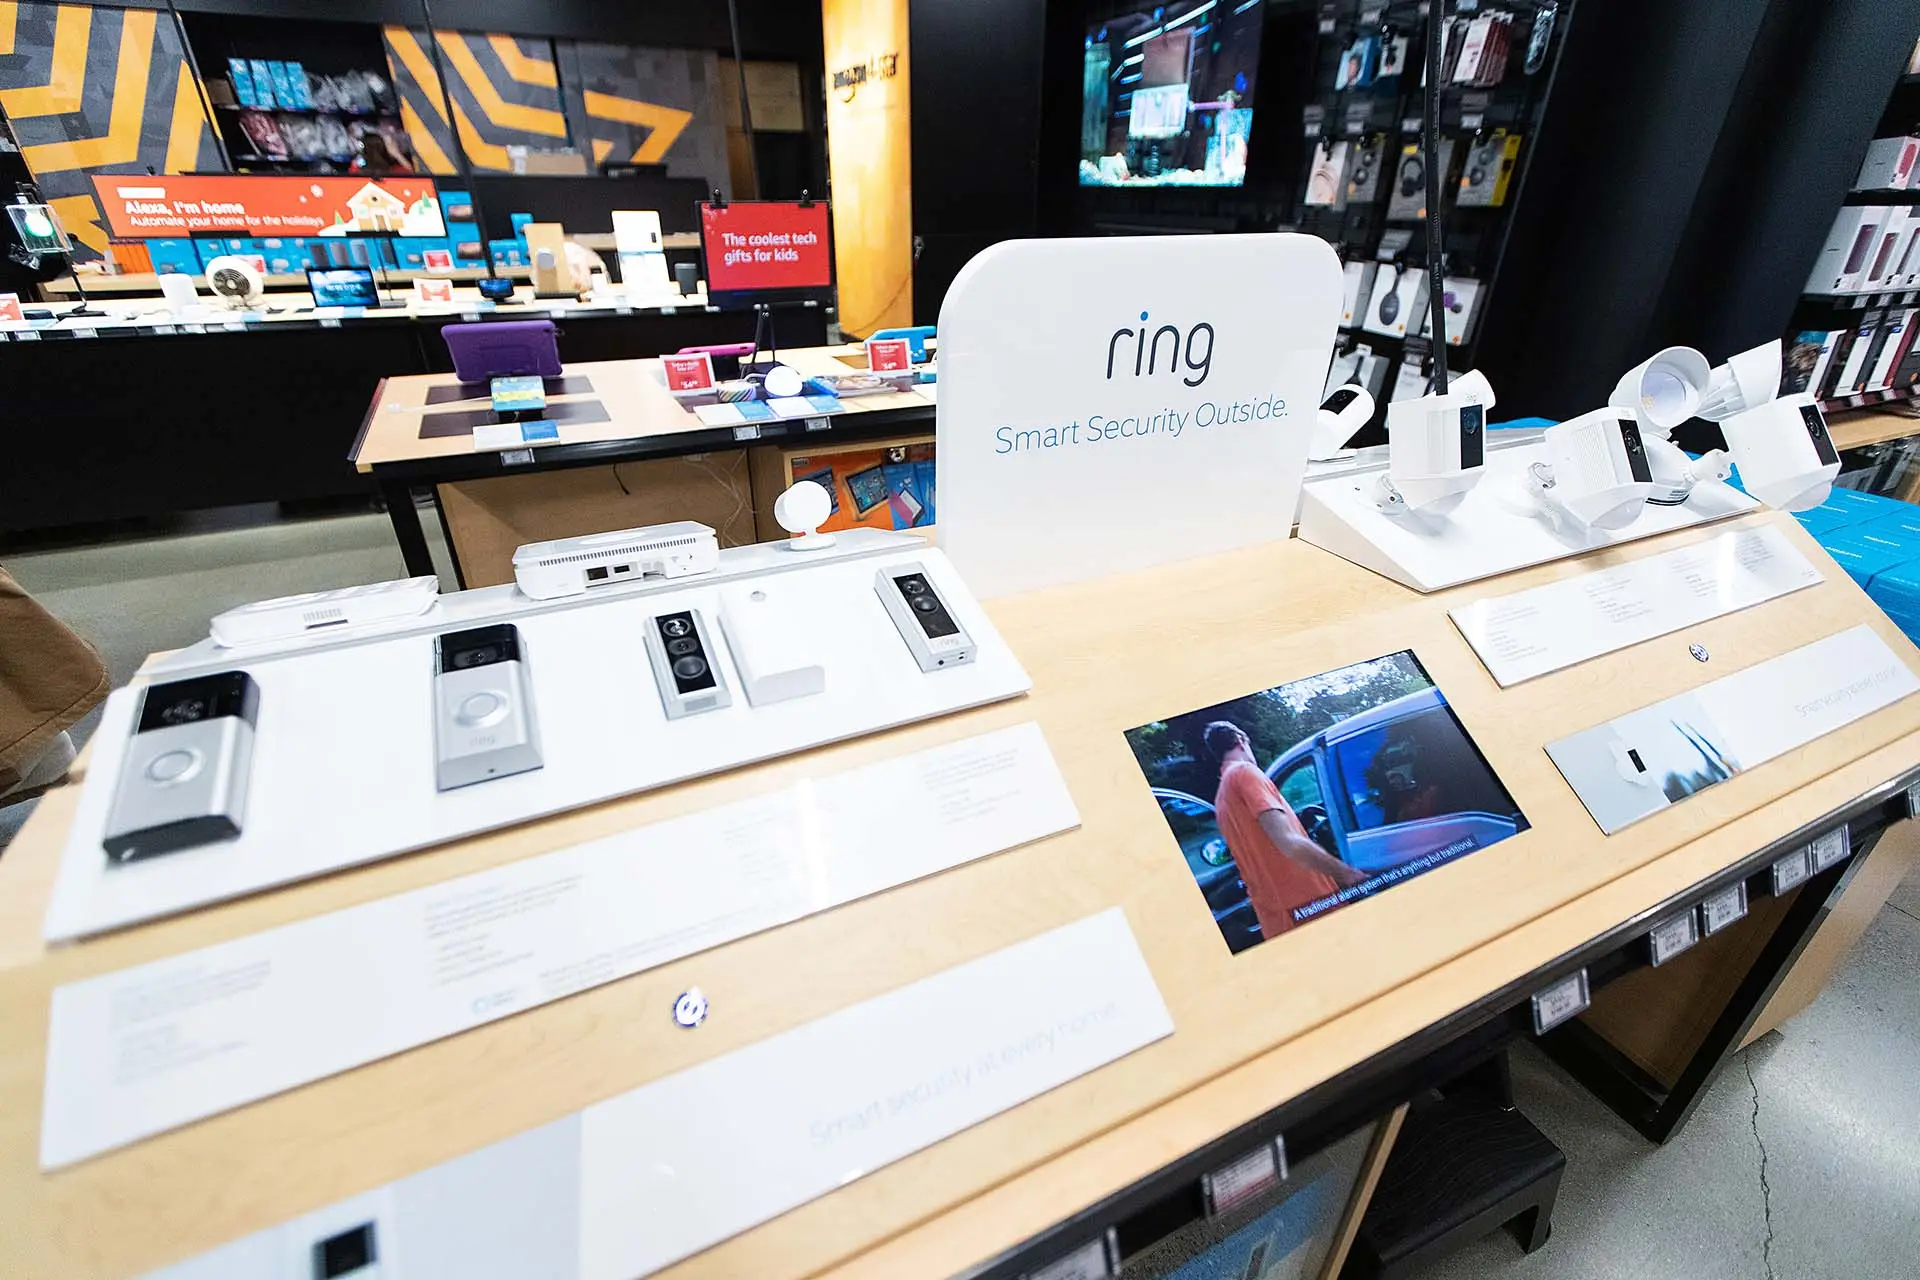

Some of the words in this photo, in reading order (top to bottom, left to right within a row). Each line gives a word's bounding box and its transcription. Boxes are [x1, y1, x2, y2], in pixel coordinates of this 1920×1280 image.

[125, 200, 173, 217] Alexa,
[175, 200, 200, 214] I'm
[201, 200, 245, 215] home
[130, 215, 185, 227] Automate
[187, 217, 211, 228] your
[213, 215, 247, 227] home
[247, 215, 261, 226] for
[263, 214, 281, 226] the
[722, 233, 746, 246] The
[748, 232, 791, 245] coolest
[792, 231, 817, 245] tech
[724, 250, 753, 266] gifts
[754, 248, 772, 262] for
[774, 248, 799, 261] kids
[1106, 310, 1214, 387] ring
[995, 420, 1080, 454] Smart
[1086, 407, 1189, 442] Security
[1195, 393, 1289, 427] Outside.
[1301, 893, 1339, 918] traditional
[1338, 887, 1361, 902] alarm
[1359, 877, 1383, 896] system
[1382, 869, 1402, 884] that's
[1401, 857, 1431, 877] anything
[1429, 852, 1442, 864] but
[807, 1098, 884, 1153] Smart
